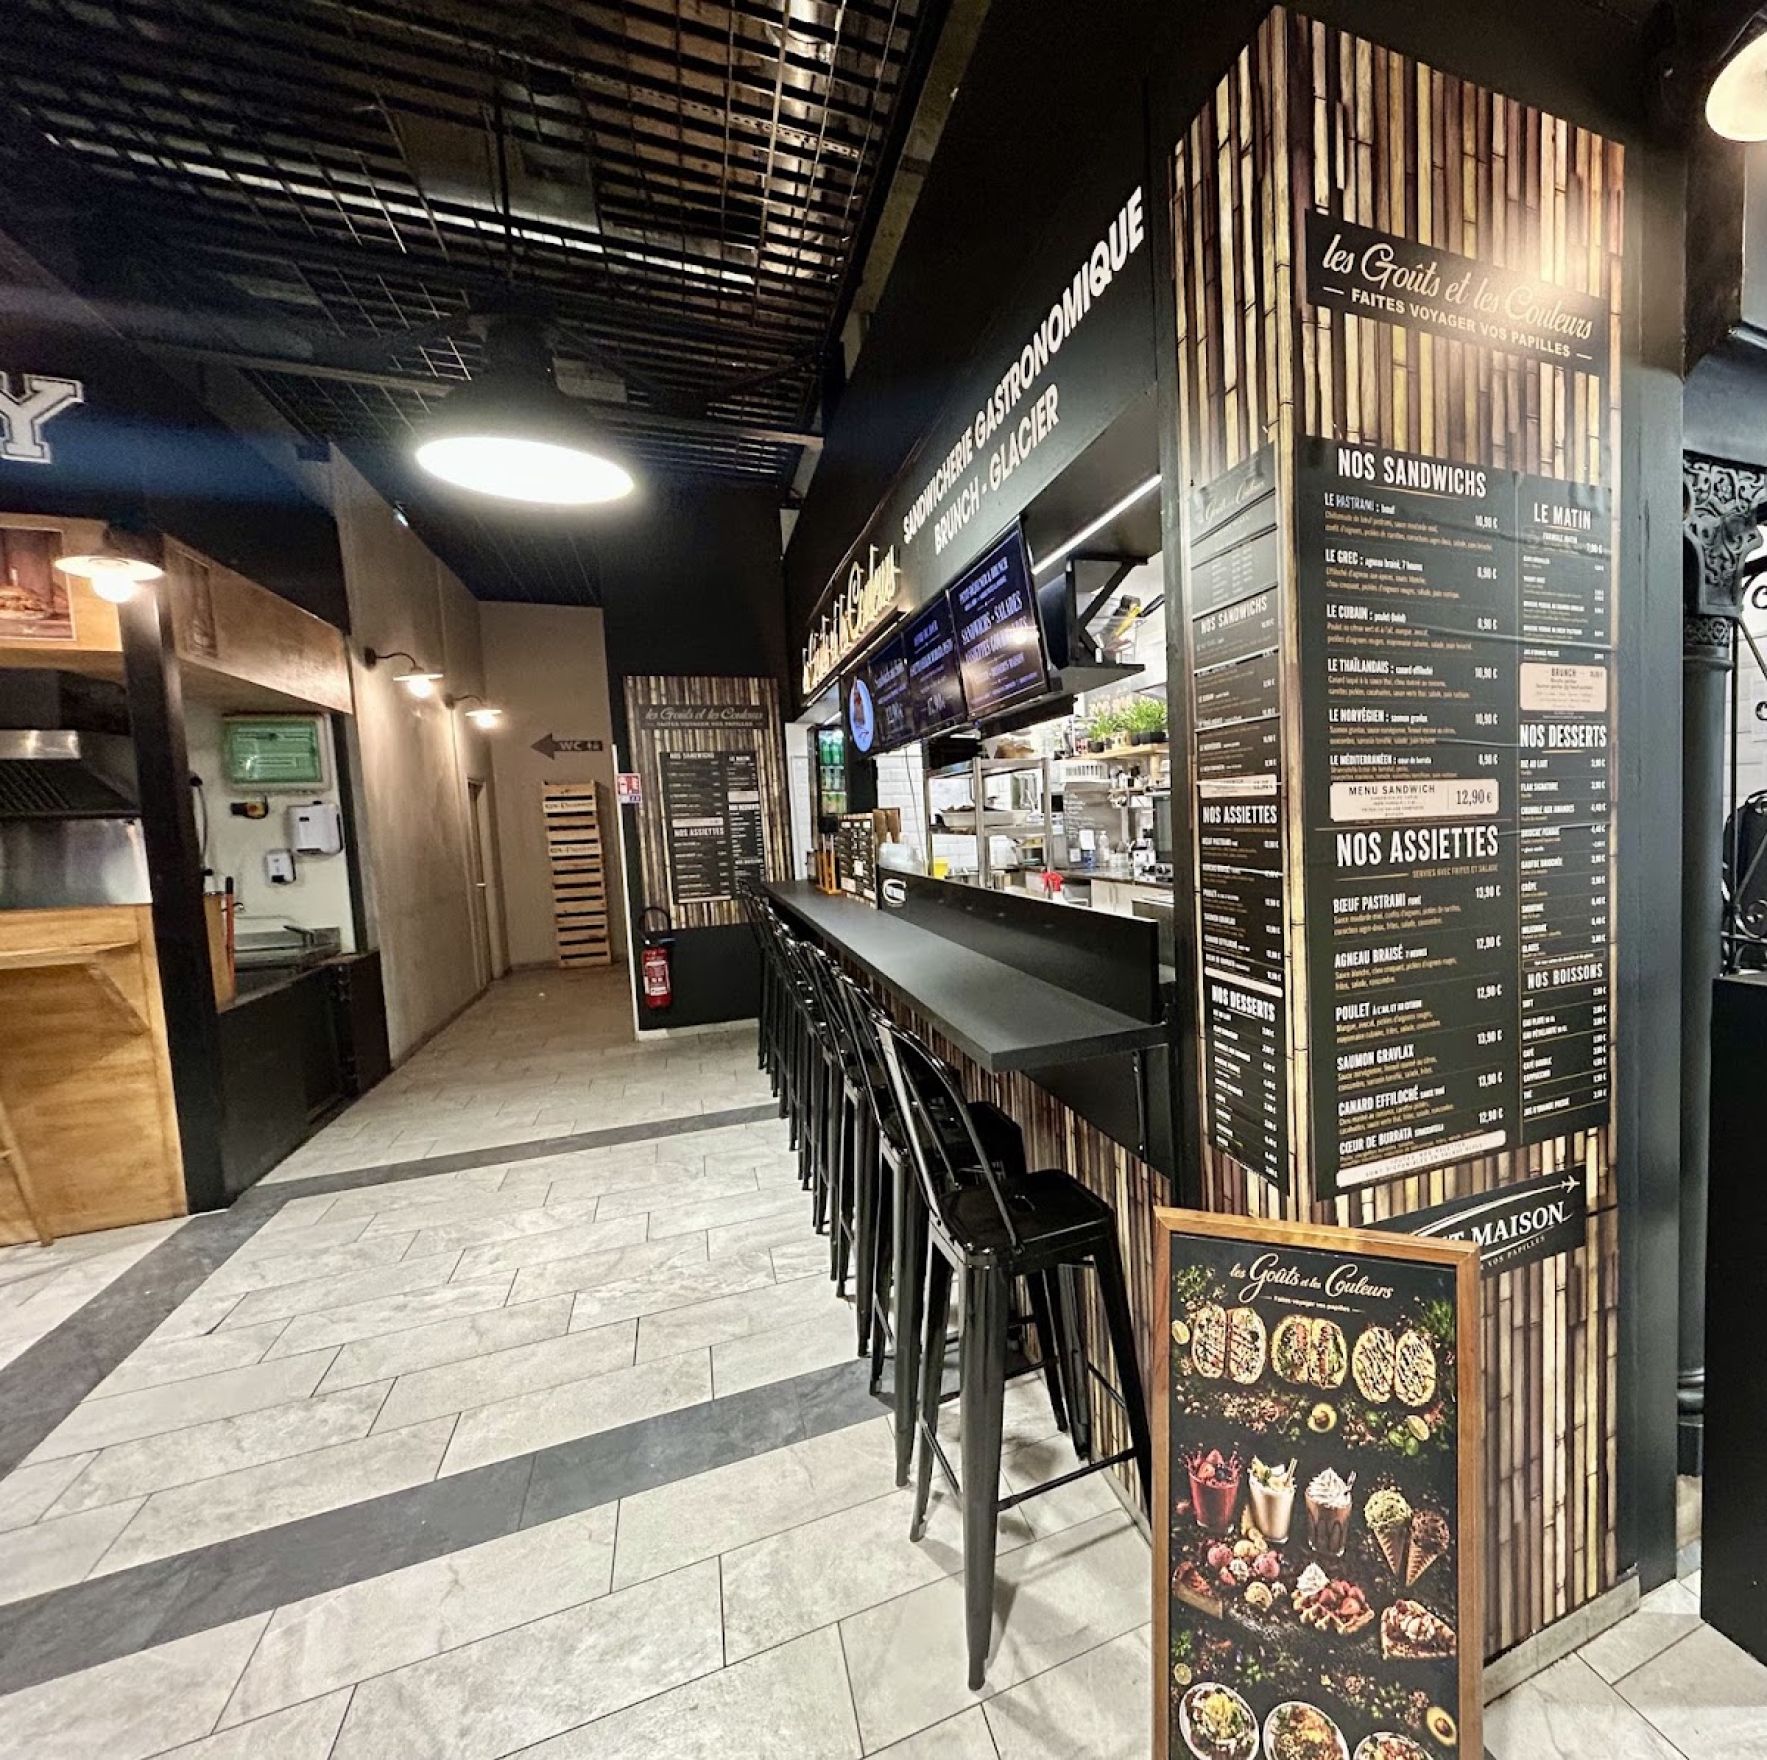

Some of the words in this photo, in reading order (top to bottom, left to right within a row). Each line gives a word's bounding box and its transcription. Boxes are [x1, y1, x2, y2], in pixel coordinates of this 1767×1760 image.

[1323, 234, 1354, 275] les
[1361, 243, 1440, 297] Goûts
[1445, 272, 1472, 304] et
[1474, 277, 1499, 311] les
[1506, 286, 1593, 340] Couleurs
[1352, 289, 1405, 314] FAITES
[1409, 303, 1475, 334] VOYAGER
[1480, 323, 1506, 341] VOS
[1512, 332, 1570, 358] PAPILLES
[903, 425, 973, 544] SANDWICHERIE
[974, 185, 1144, 449] GASTRONOMIQUE
[934, 476, 980, 554] BRUNCH
[989, 383, 1060, 492] GLACIER
[1337, 448, 1375, 480] NOS
[1384, 456, 1487, 498] SANDWICHS
[1324, 492, 1334, 507] LE
[1534, 502, 1549, 523] LE
[1553, 505, 1591, 530] MATIN
[1325, 548, 1335, 563] LE
[1337, 550, 1358, 565] GREC
[1201, 616, 1216, 634] NOS
[1219, 596, 1267, 629] SANDWICHS
[1327, 604, 1338, 618] LE
[1327, 658, 1337, 672] LE
[1329, 709, 1338, 722] LE
[560, 741, 581, 751] WC
[1520, 724, 1545, 747] NOS
[1549, 724, 1607, 747] DESSERTS
[1329, 755, 1338, 765] LE
[1349, 785, 1378, 796] MENU
[1382, 784, 1435, 794] SANDWICH
[1457, 789, 1484, 806] 12,90
[1203, 806, 1221, 824] NOS
[1223, 805, 1277, 824] ASSIETTES
[1336, 832, 1382, 867] NOS
[1390, 825, 1498, 864] ASSIETTES
[1334, 898, 1359, 913] BŒUF
[1362, 892, 1405, 911] PASTRAMI
[1334, 950, 1370, 968] AGNEAU
[1372, 944, 1403, 963] BRAISÉ
[1527, 971, 1549, 990] NOS
[1553, 963, 1603, 985] BOISSONS
[1230, 990, 1276, 1022] DESSERTS
[1335, 1002, 1370, 1021] POULET
[1337, 1051, 1374, 1072] SAUMON
[1377, 1044, 1414, 1064] GRAVLAX
[1338, 1097, 1375, 1117] CANARD
[1376, 1084, 1419, 1107] EFFILOCHÉ
[1366, 1135, 1377, 1148] DE
[1378, 1127, 1412, 1147] BURRATA
[1471, 1201, 1565, 1247] MAISON
[1229, 1263, 1246, 1278] les
[1238, 1253, 1300, 1303] Goûts
[1325, 1264, 1394, 1299] Couleurs
